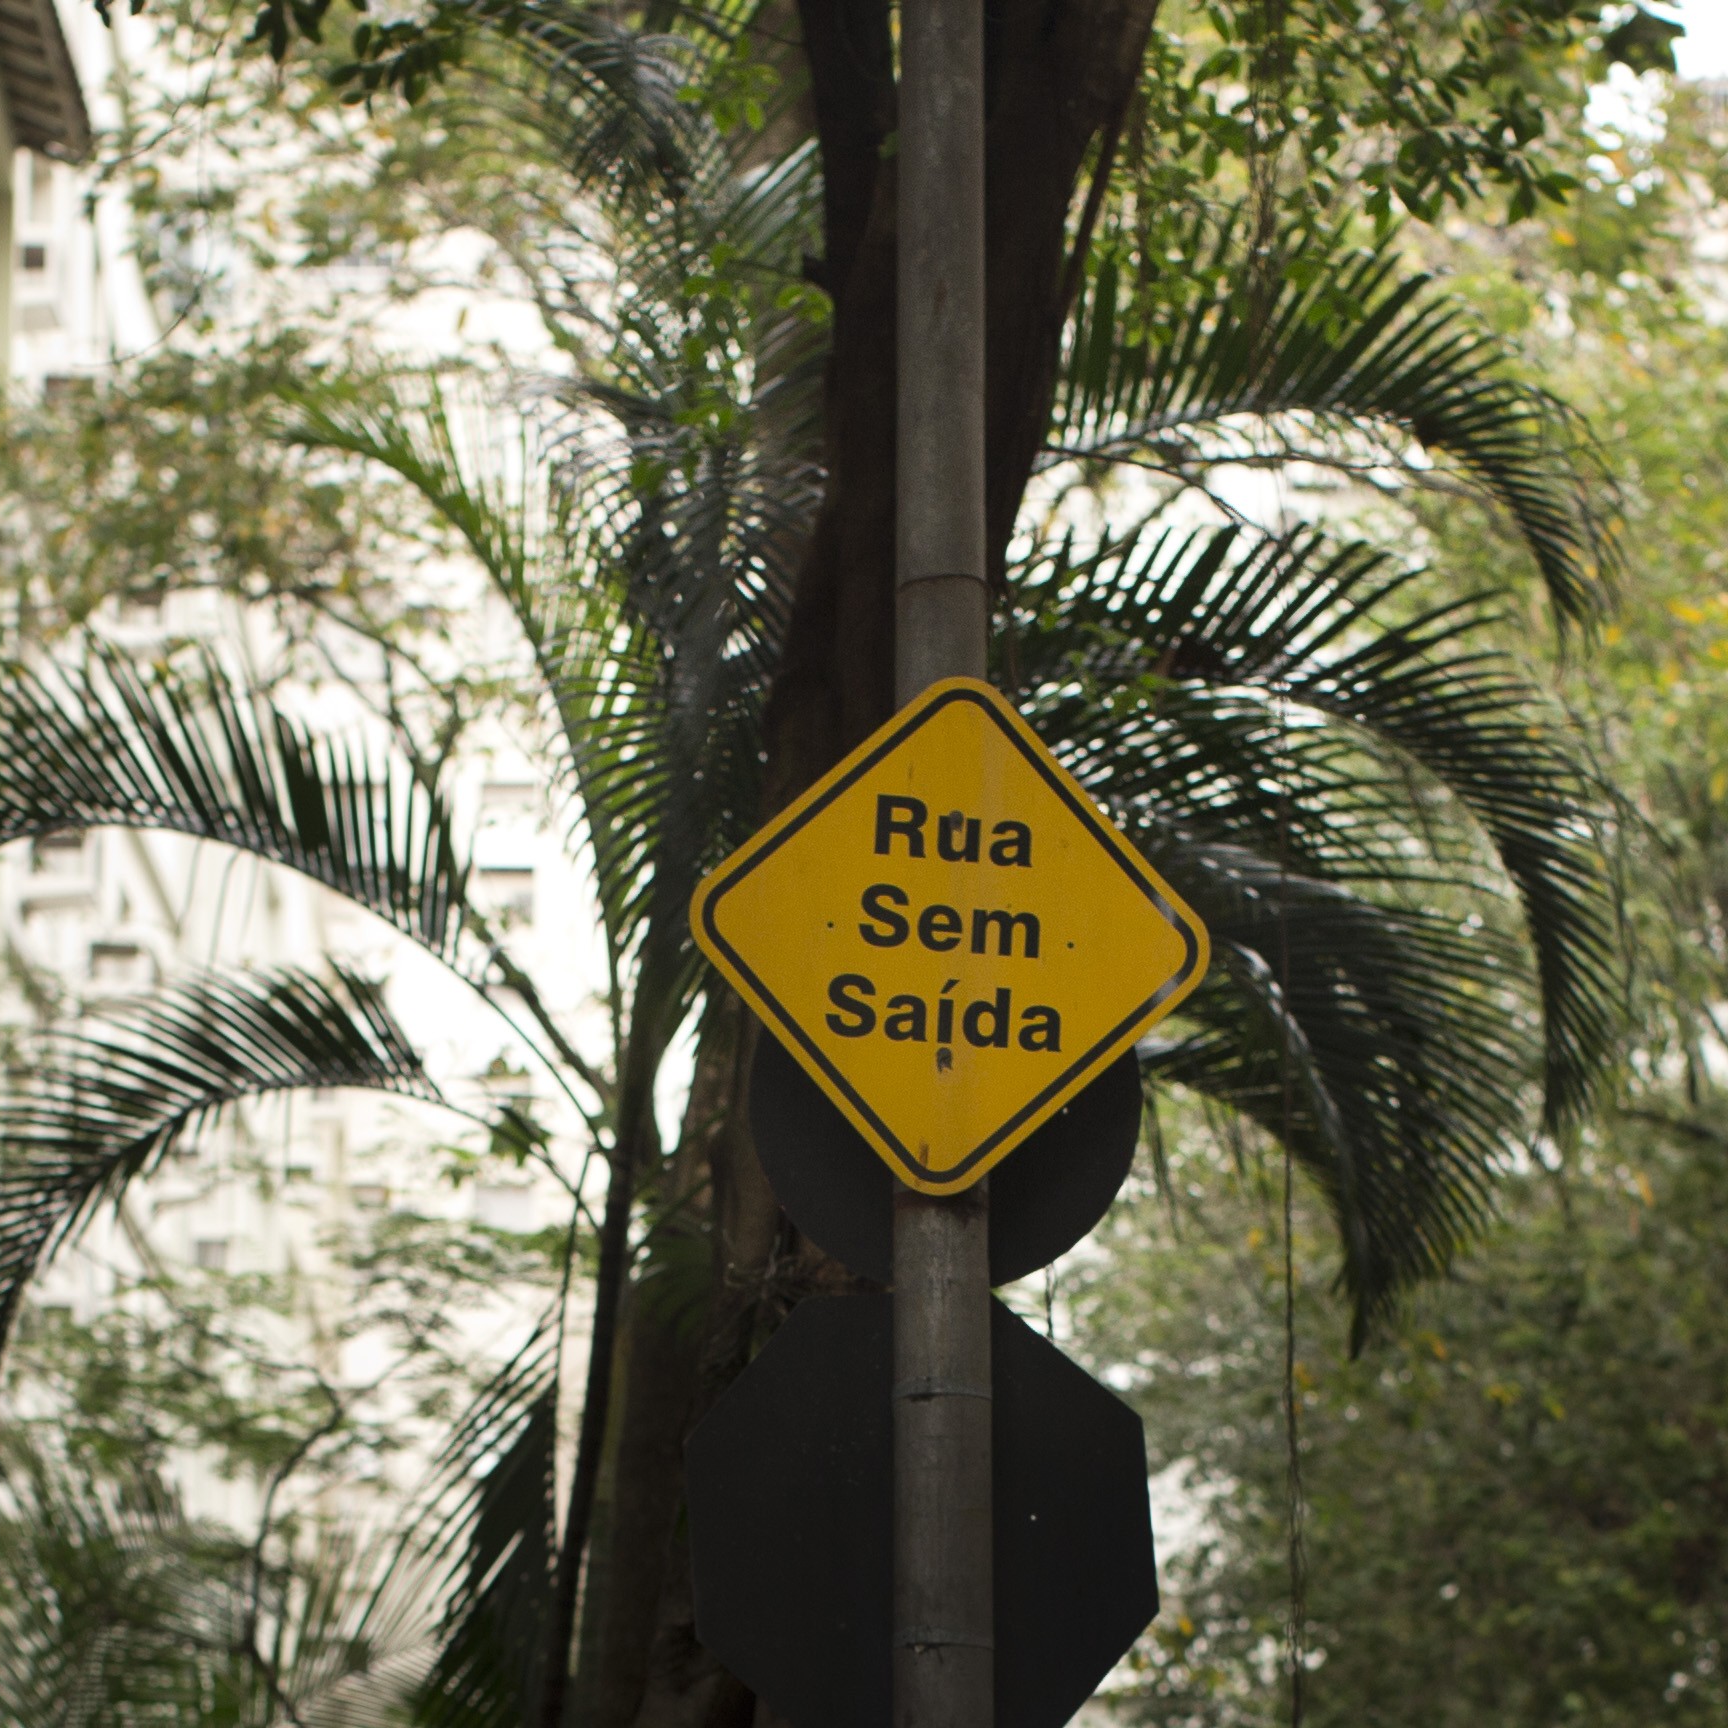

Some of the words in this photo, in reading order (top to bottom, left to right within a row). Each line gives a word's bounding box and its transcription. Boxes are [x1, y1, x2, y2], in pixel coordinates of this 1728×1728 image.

[873, 794, 1033, 868] Rua
[858, 883, 1041, 959] Sem
[825, 973, 1062, 1053] Saída
